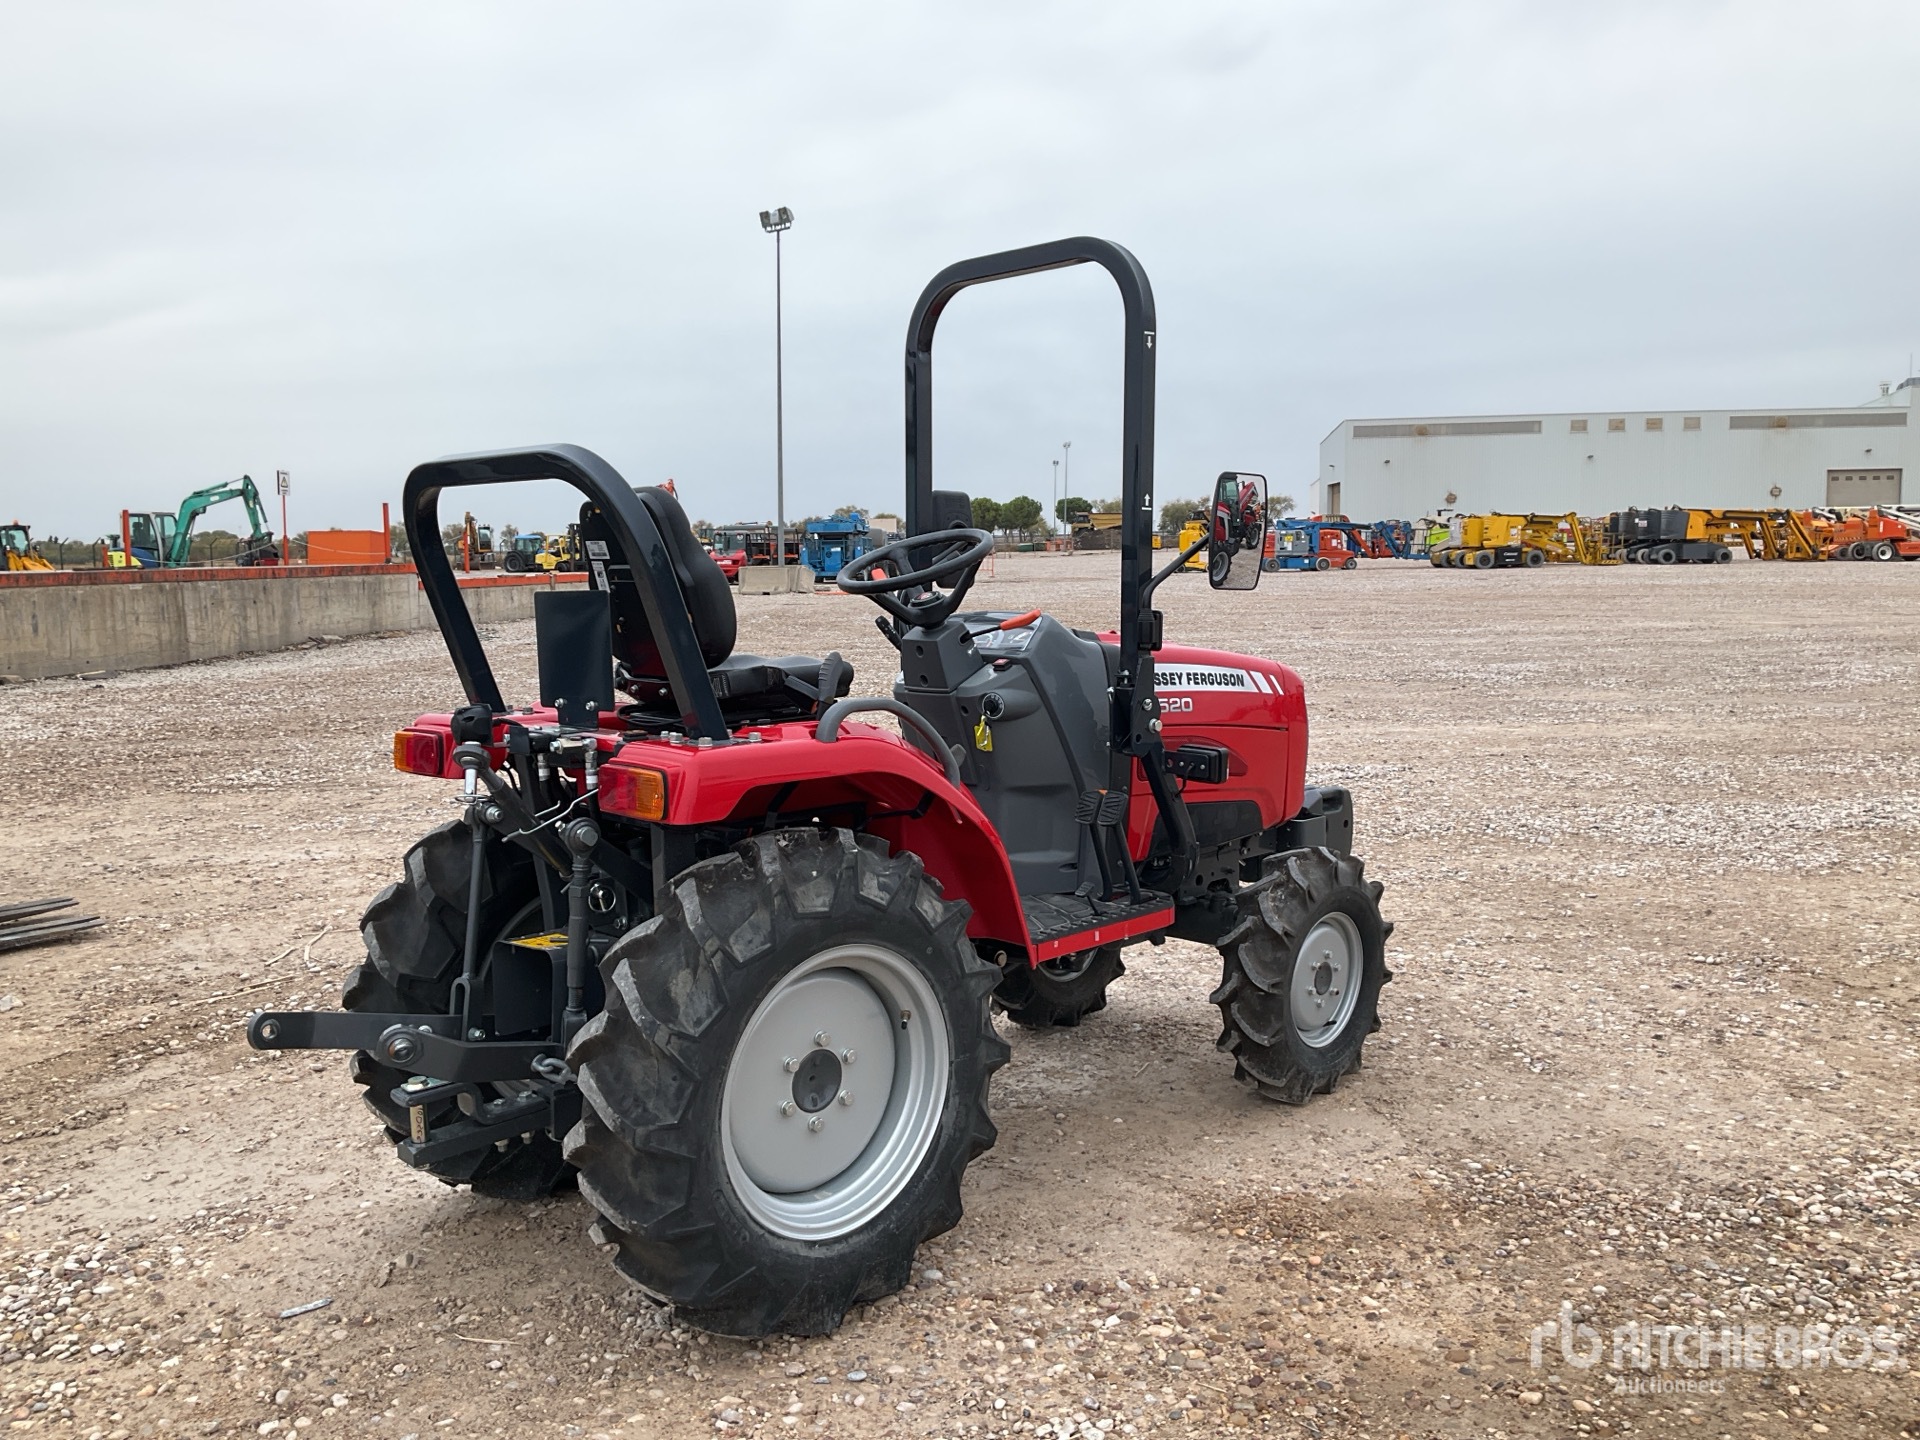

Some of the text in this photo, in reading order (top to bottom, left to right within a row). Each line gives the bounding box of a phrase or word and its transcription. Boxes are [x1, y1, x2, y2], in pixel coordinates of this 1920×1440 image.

[1153, 671, 1245, 687] SSEY FERGUSON
[1158, 697, 1193, 713] 520
